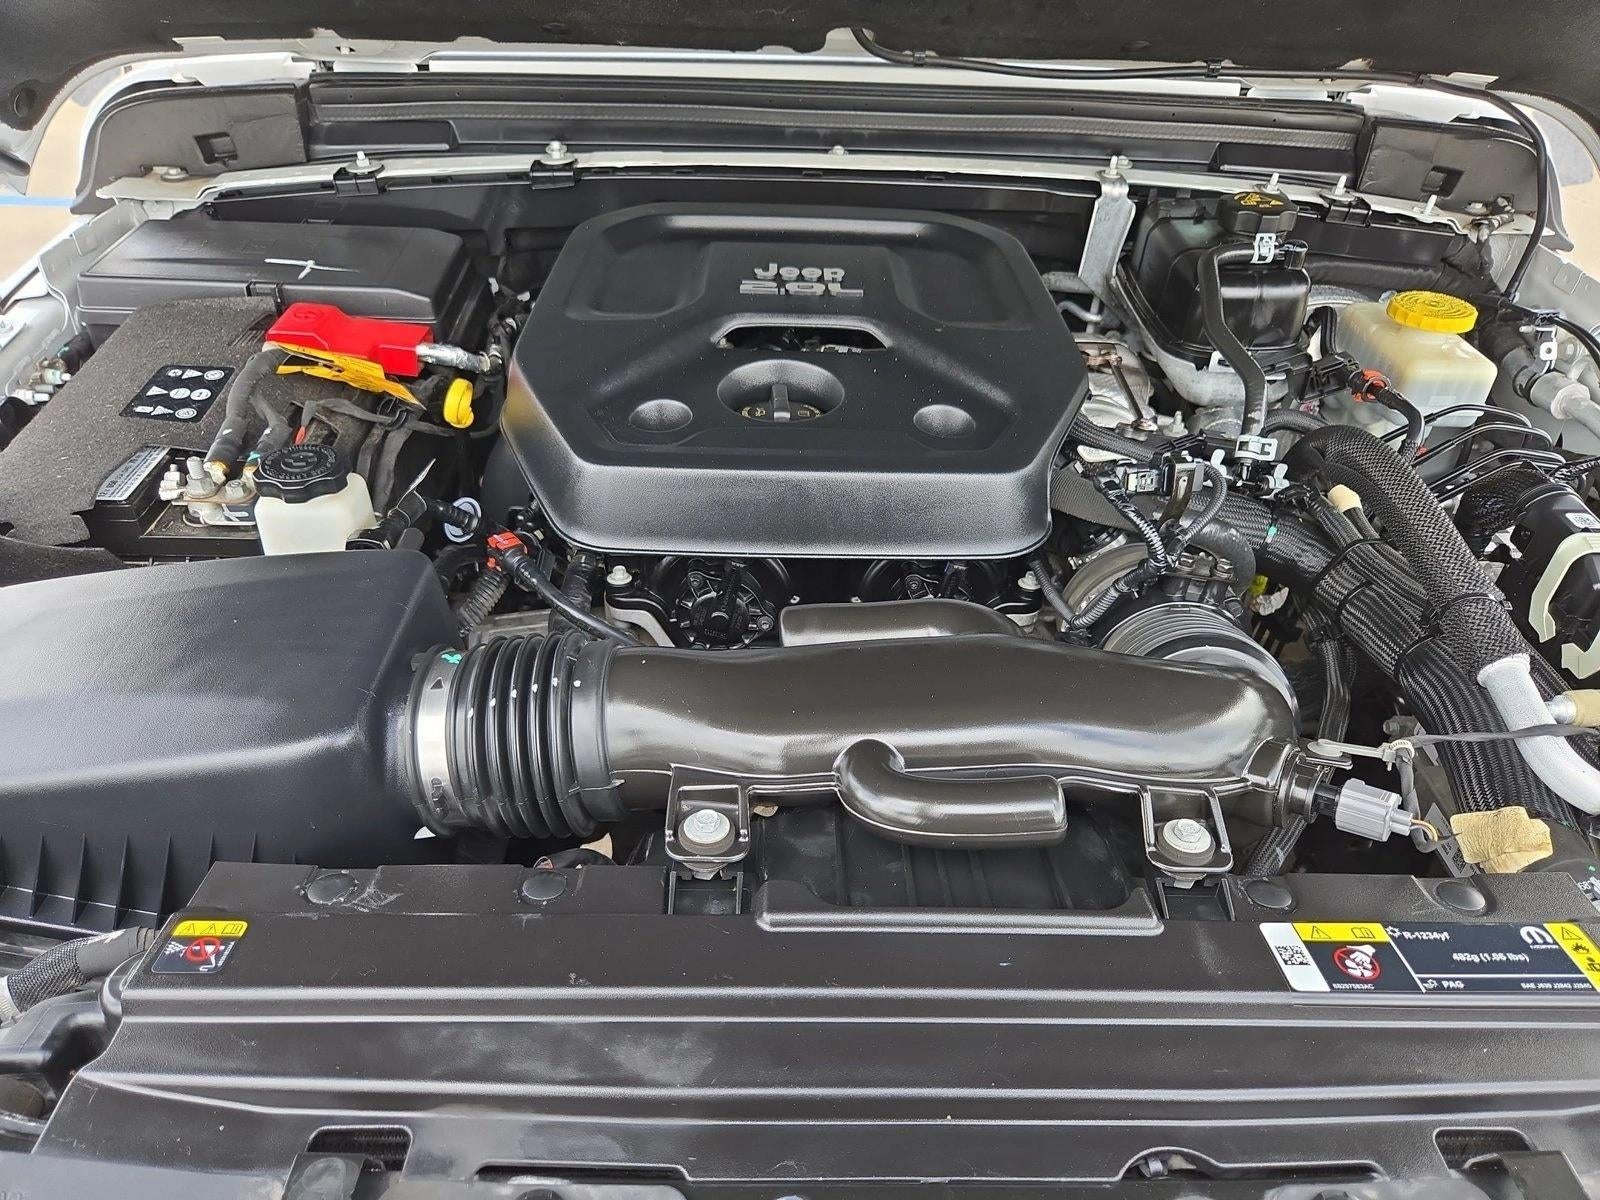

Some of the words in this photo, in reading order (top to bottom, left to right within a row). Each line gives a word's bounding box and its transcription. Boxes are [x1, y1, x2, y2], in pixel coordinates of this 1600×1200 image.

[754, 262, 845, 281] Jeep
[740, 279, 864, 297] 2.0L
[1402, 931, 1450, 942] R-1234yf
[1506, 952, 1530, 963] lbs)
[1441, 980, 1466, 989] PAG
